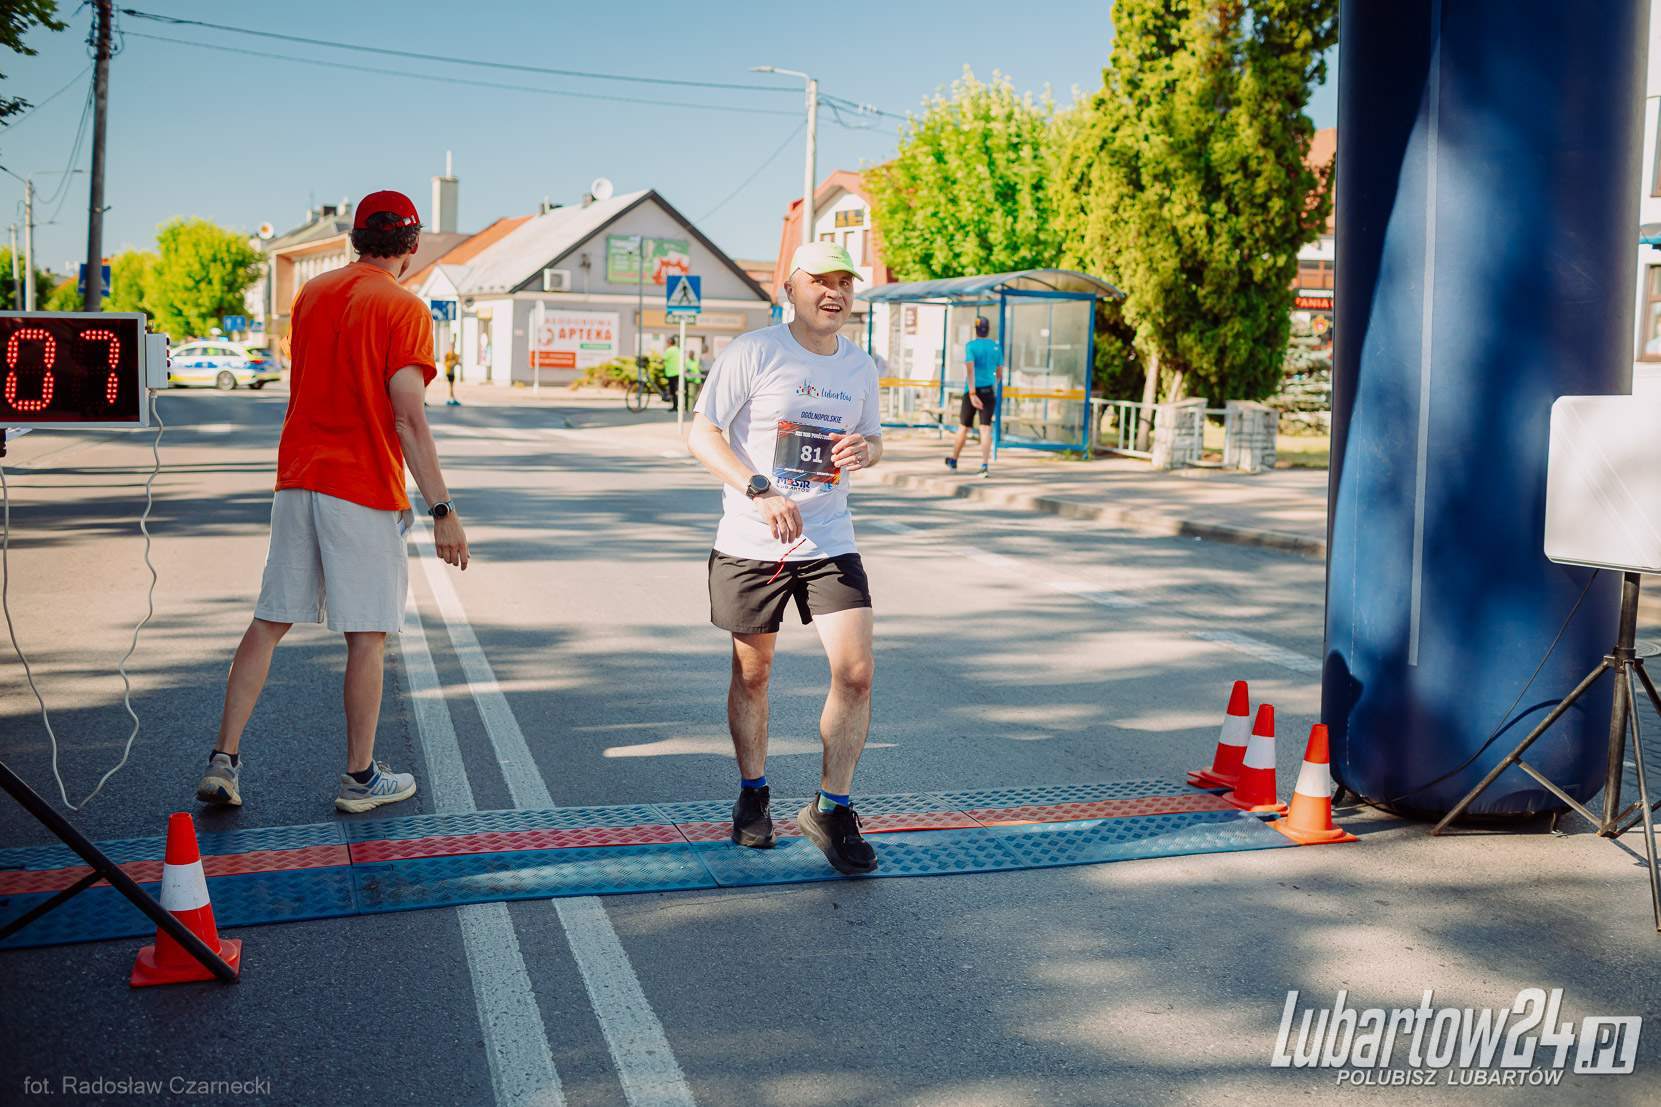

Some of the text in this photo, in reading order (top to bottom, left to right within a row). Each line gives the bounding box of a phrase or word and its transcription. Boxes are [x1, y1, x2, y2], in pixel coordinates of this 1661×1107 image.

[559, 327, 612, 340] APTEKA
[800, 411, 842, 423] OGÓLNOPOLSKIE
[800, 445, 823, 464] 81
